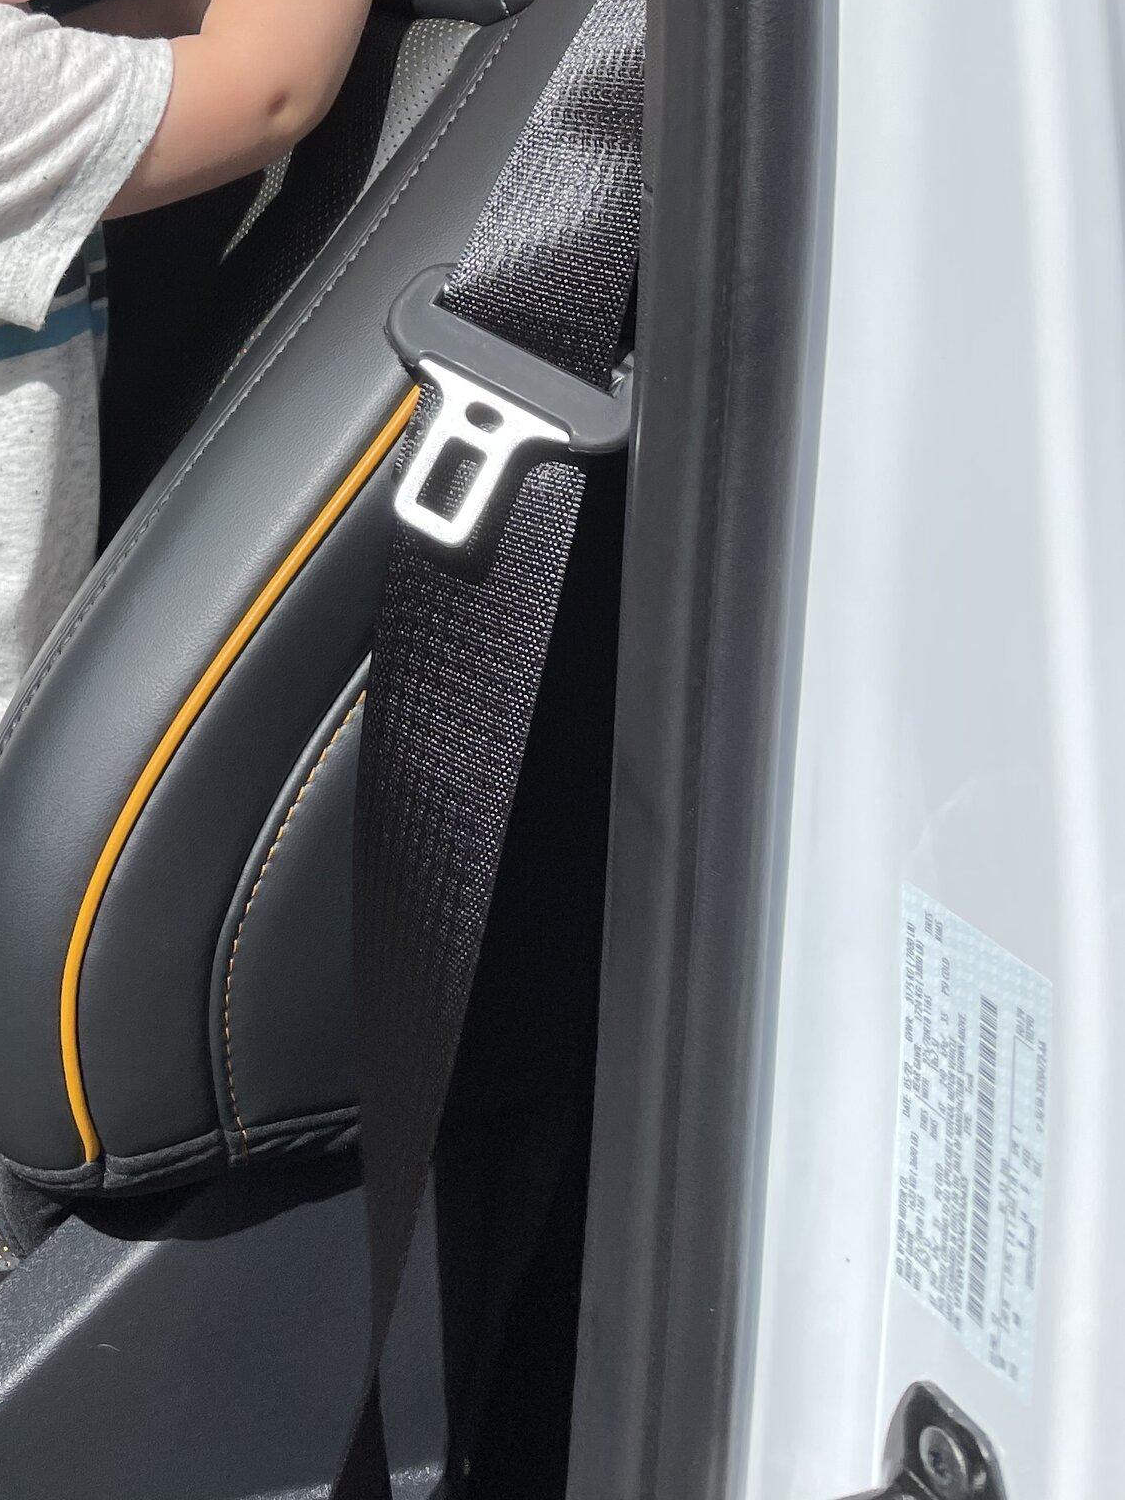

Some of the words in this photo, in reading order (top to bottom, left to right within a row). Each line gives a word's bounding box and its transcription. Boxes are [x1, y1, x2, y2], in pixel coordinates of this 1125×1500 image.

[923, 909, 933, 936] TIRES
[934, 917, 943, 943] RIMS
[905, 965, 914, 982] KG
[940, 955, 950, 982] COLD
[914, 983, 923, 1000] KG
[947, 1034, 956, 1071] VEHICLE
[956, 1041, 965, 1076] SHOWN
[903, 1059, 912, 1092] 05/22
[946, 1069, 955, 1103] MOTOR
[945, 1101, 954, 1140] FEDERAL
[897, 1185, 907, 1221] MOTOR
[896, 1216, 905, 1244] FORD
